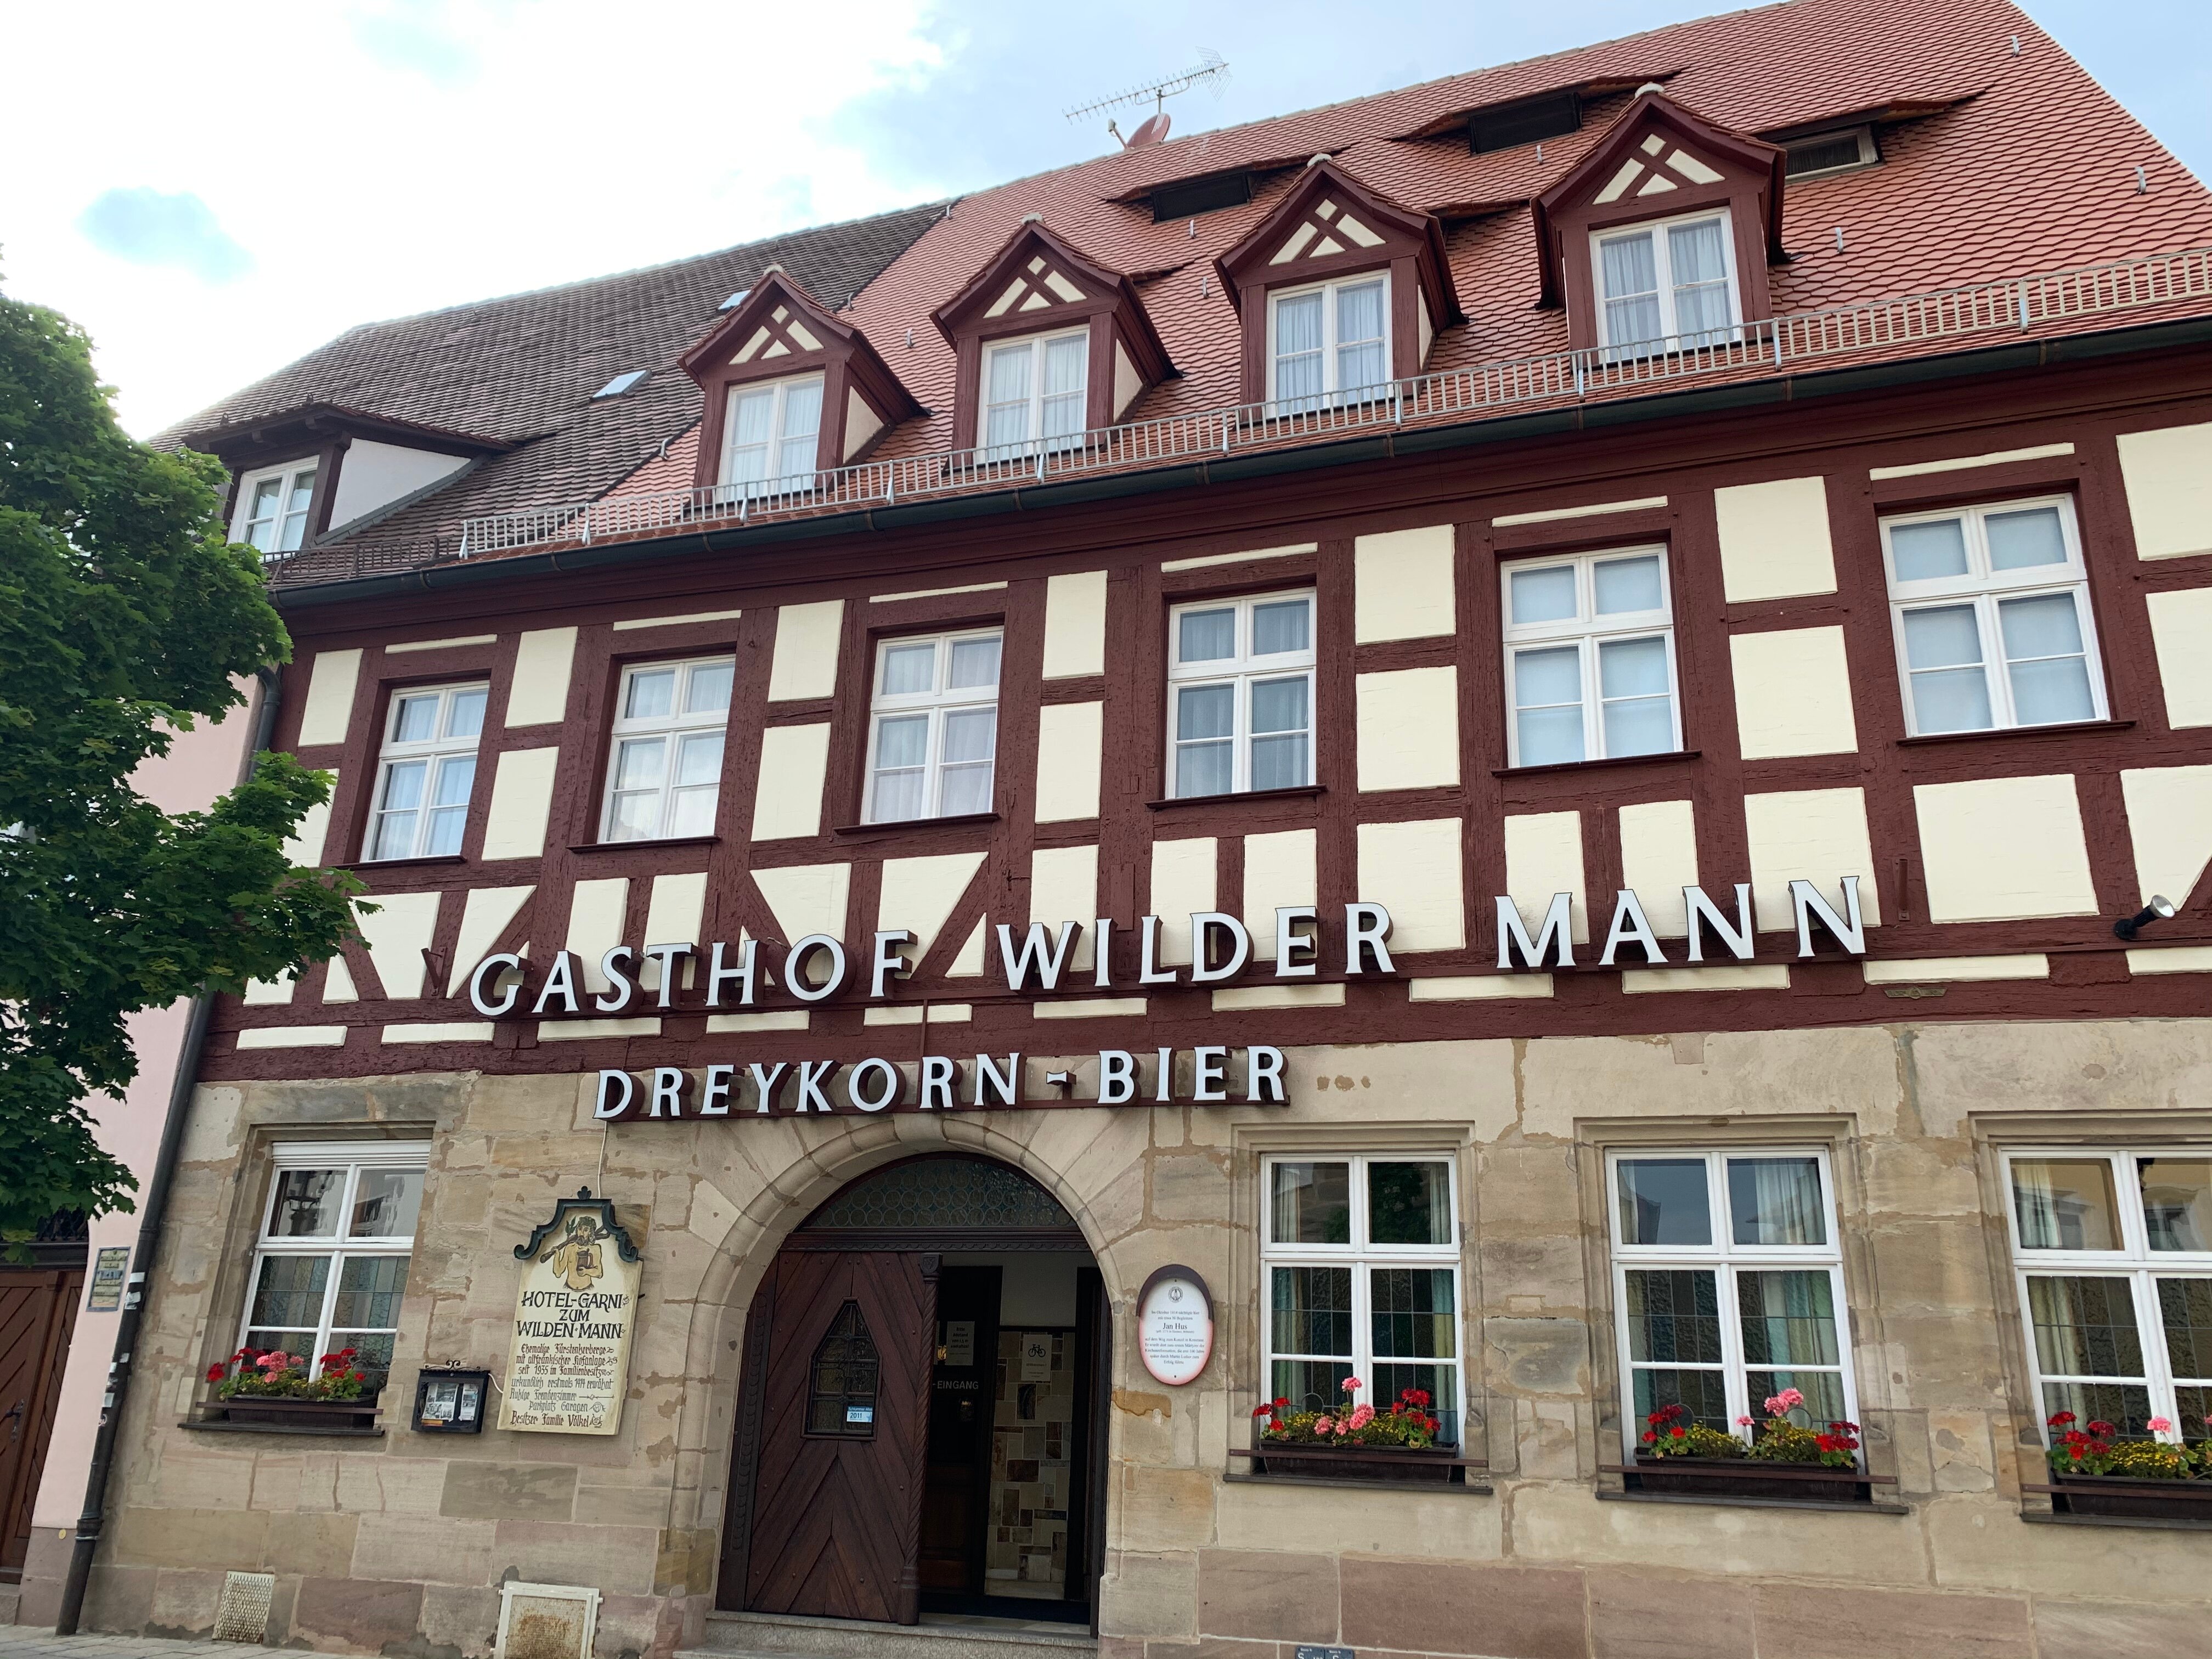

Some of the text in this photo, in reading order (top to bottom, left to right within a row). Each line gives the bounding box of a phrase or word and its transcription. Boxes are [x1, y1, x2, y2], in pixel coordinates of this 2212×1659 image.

[470, 876, 1866, 1017] GASTHOF WILDER MANN
[592, 1052, 1020, 1120] DREYKORN
[1097, 1045, 1286, 1104] BIER
[521, 1291, 623, 1312] HOTEL-GARNI
[559, 1309, 590, 1322] ZUM
[516, 1321, 624, 1339] WILDEN MANN
[521, 1343, 550, 1355] Ehemalige
[516, 1354, 526, 1364] mit
[518, 1364, 530, 1374] seit
[534, 1365, 548, 1375] 1935
[550, 1365, 556, 1374] im
[541, 1413, 564, 1426] Familie
